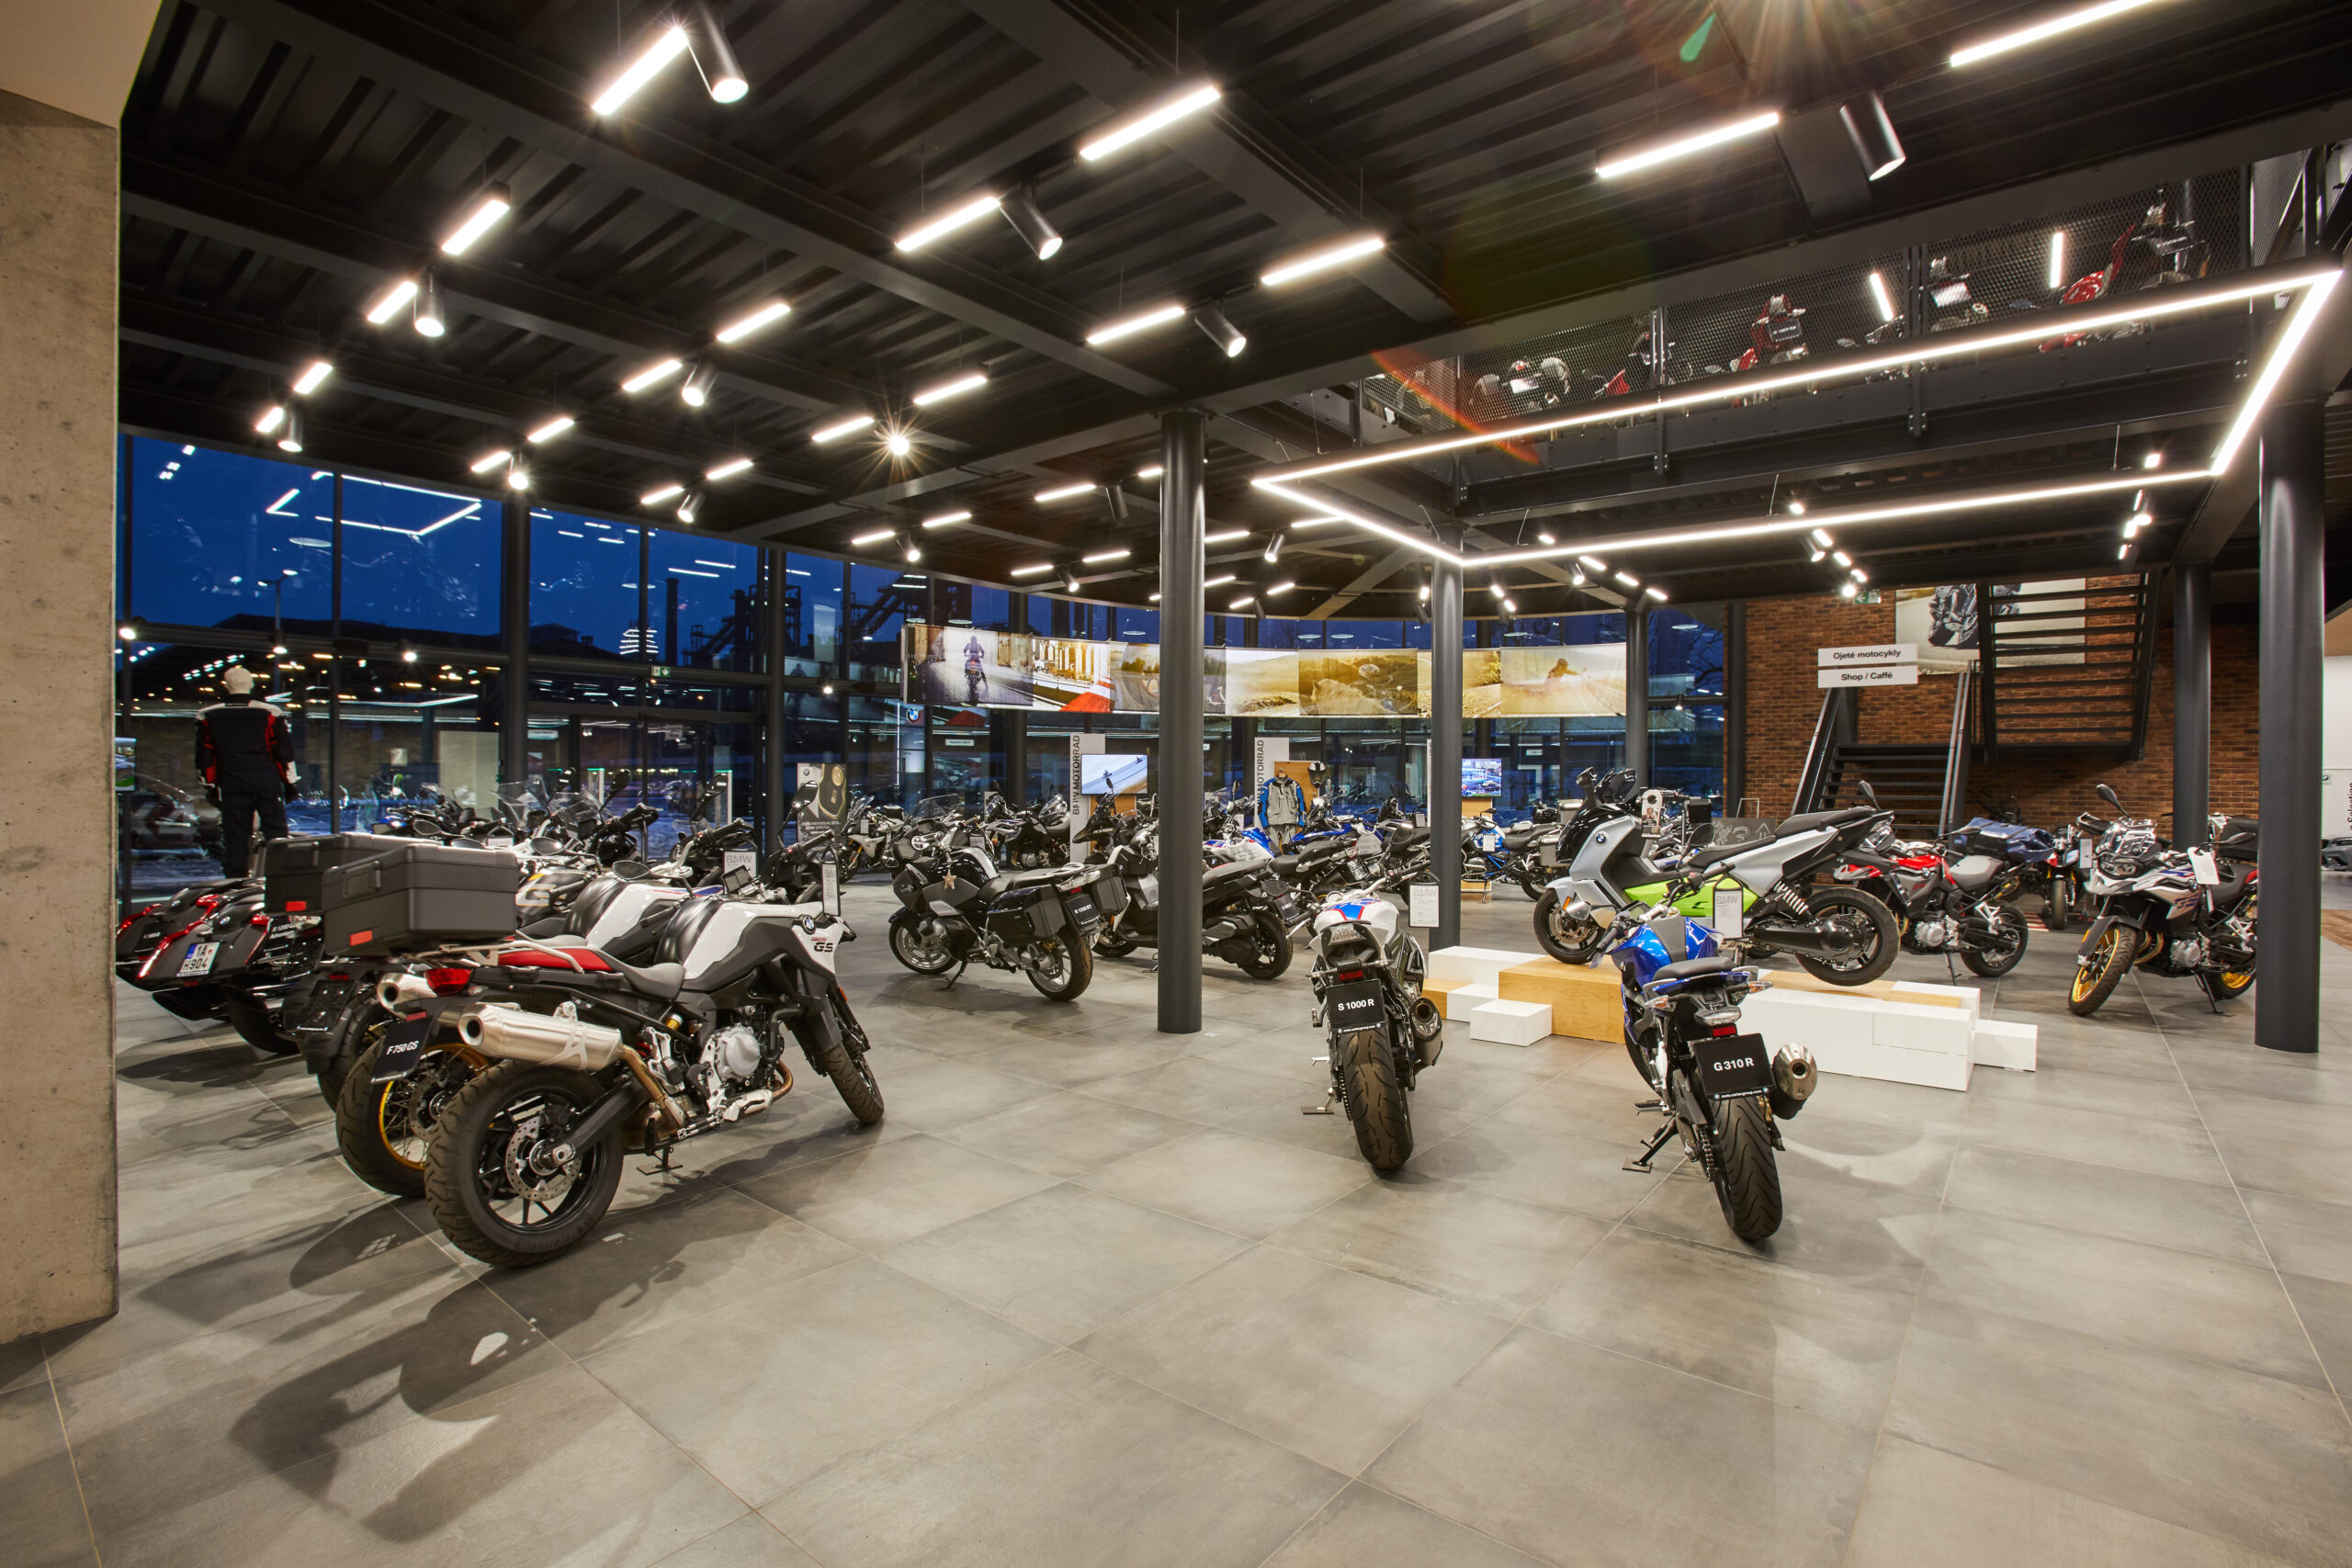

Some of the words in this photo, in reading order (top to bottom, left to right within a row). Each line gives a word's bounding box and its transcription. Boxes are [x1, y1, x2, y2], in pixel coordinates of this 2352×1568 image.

[1833, 651, 1855, 660] Ojeté
[1857, 649, 1902, 658] motocykly
[1841, 673, 1863, 682] Shop
[1870, 671, 1893, 680] Caffé
[727, 855, 752, 863] BMW
[1413, 888, 1438, 897] BMW
[1716, 896, 1738, 905] BMW
[197, 945, 208, 956] 1A
[814, 942, 833, 953] GS
[1346, 1000, 1366, 1010] 1000
[387, 1045, 394, 1055] F
[392, 1043, 407, 1054] 750
[406, 1041, 419, 1051] GS
[1713, 1062, 1723, 1071] G
[1724, 1059, 1745, 1070] 310
[1745, 1057, 1754, 1066] R
